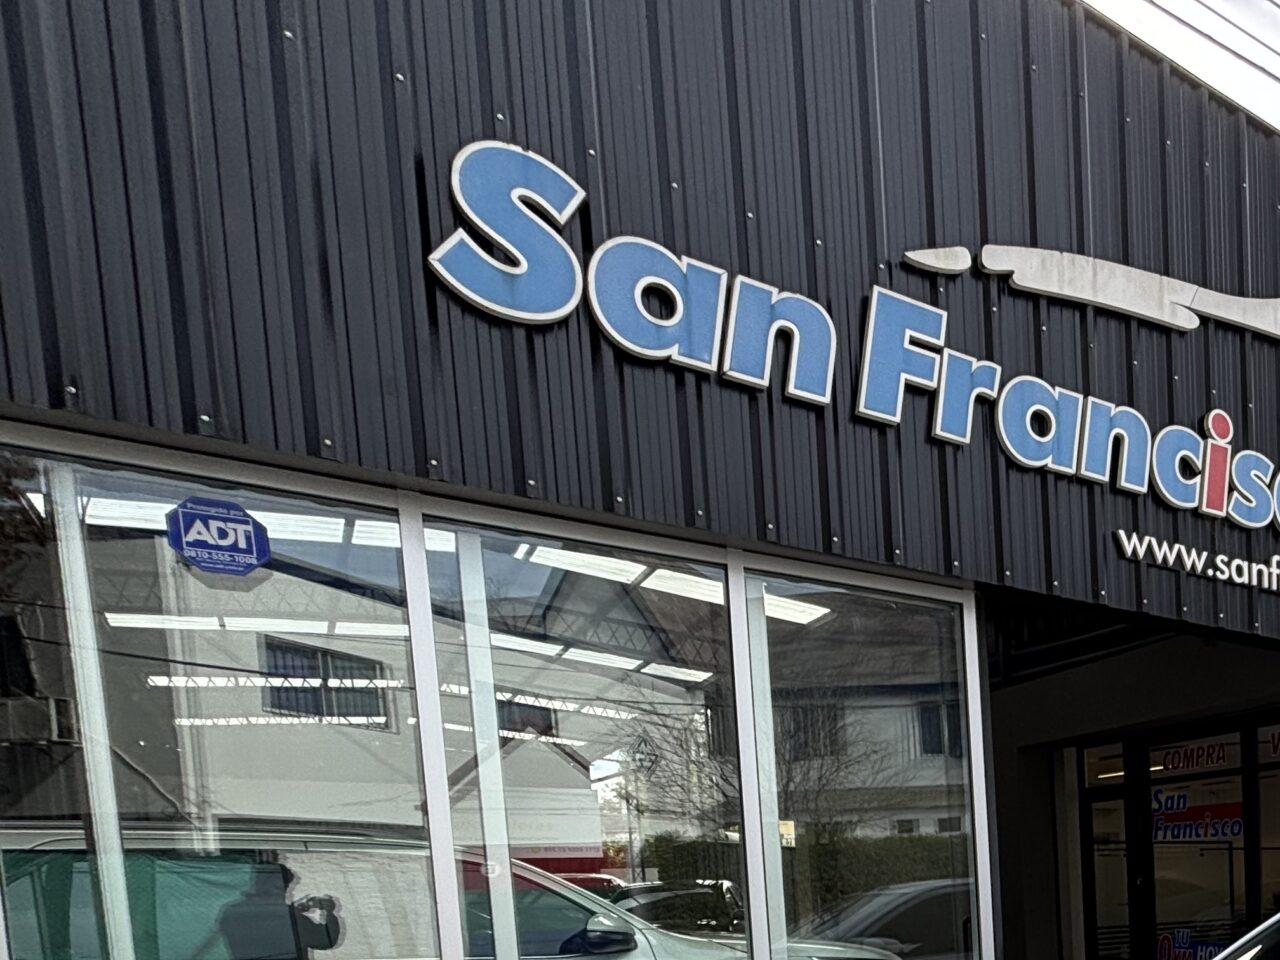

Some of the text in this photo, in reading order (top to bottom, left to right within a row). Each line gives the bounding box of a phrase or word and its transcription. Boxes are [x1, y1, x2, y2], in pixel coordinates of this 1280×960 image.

[428, 139, 837, 407] San
[184, 518, 252, 550] ADT
[1162, 742, 1228, 772] COMPRA
[1152, 788, 1188, 813] San
[1153, 813, 1243, 841] Francisco
[1174, 928, 1191, 948] TU
